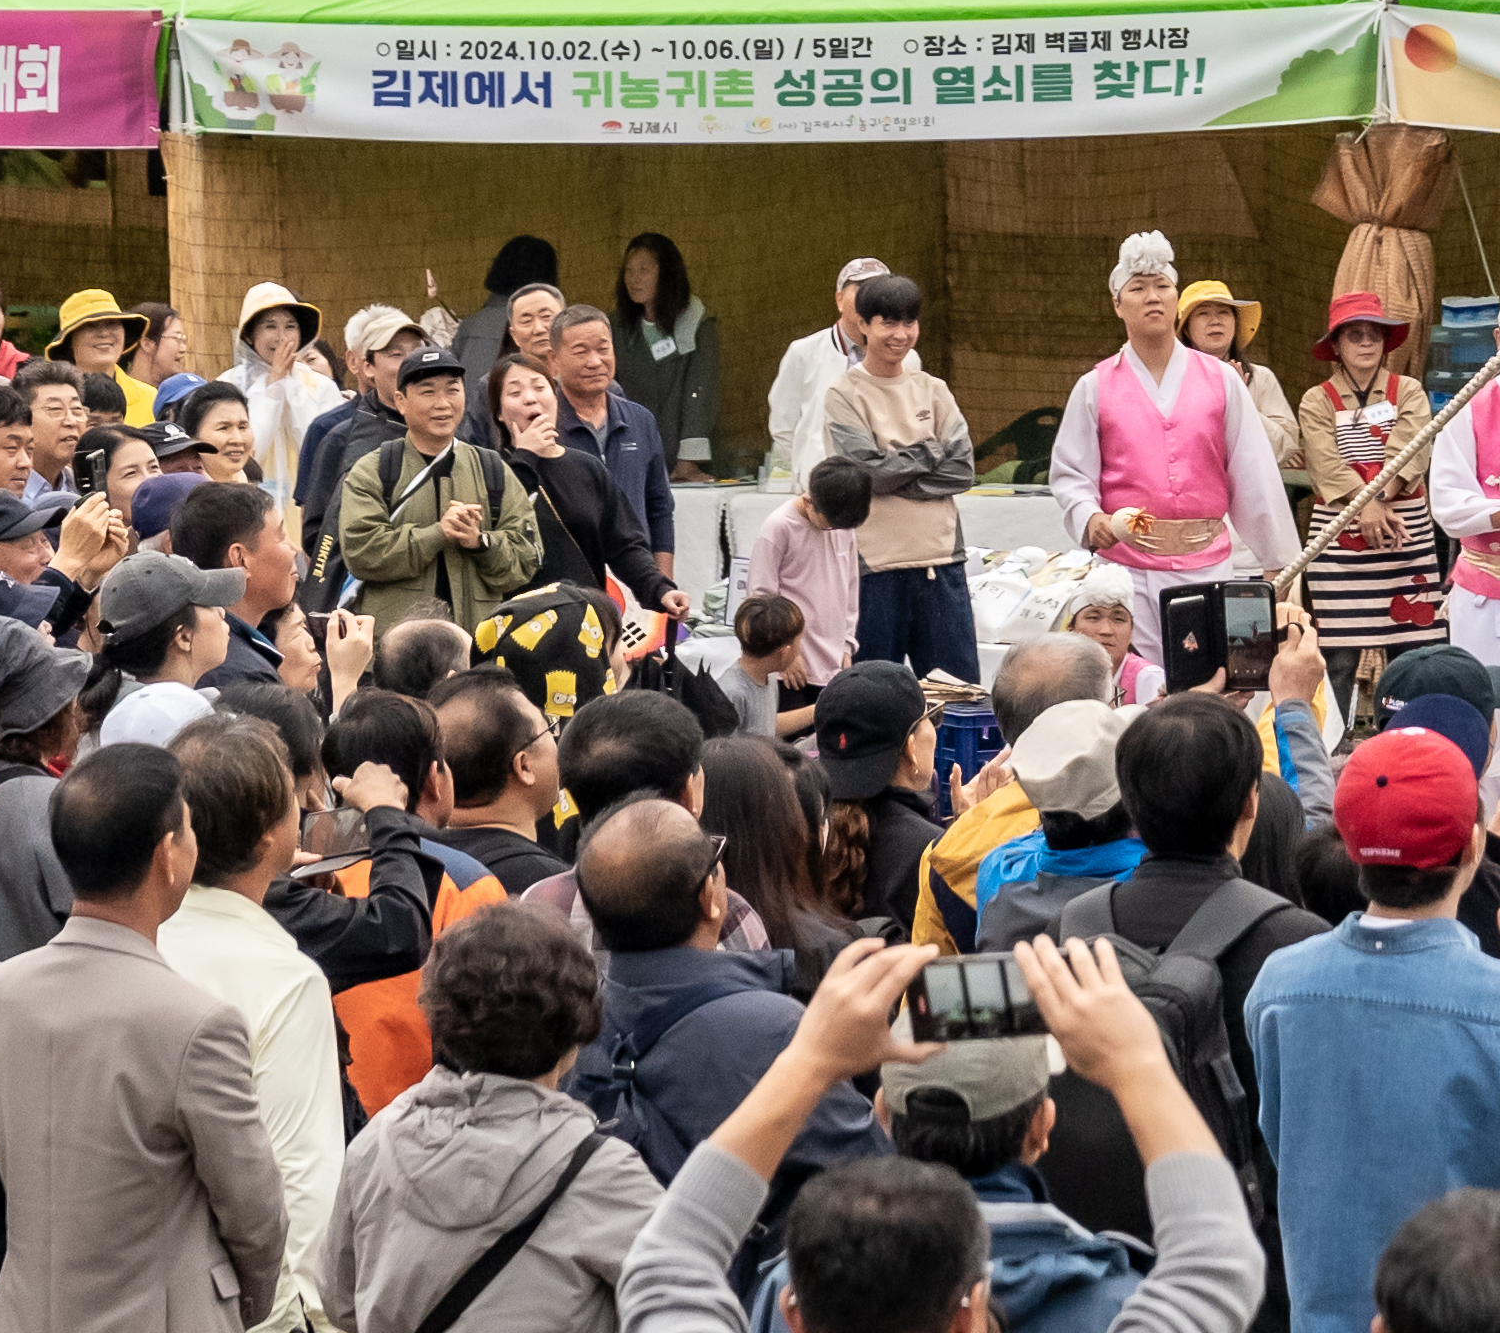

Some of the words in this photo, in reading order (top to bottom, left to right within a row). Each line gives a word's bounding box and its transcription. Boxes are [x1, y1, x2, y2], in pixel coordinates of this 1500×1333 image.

[395, 39, 438, 61] 일시
[460, 39, 642, 62] 2024.10.02.(수)
[652, 37, 785, 61] ~10.06.(일)
[812, 36, 873, 60] 5일간
[923, 34, 968, 58] 장소
[992, 32, 1036, 56] 김제
[1045, 30, 1112, 54] 벽골제
[1121, 27, 1190, 51] 행사장
[371, 69, 553, 108] 김제에서
[572, 68, 755, 109] 귀농귀촌
[773, 66, 912, 108] 성공의
[932, 62, 1074, 105] 열쇠를
[1093, 57, 1207, 101] 찾다!
